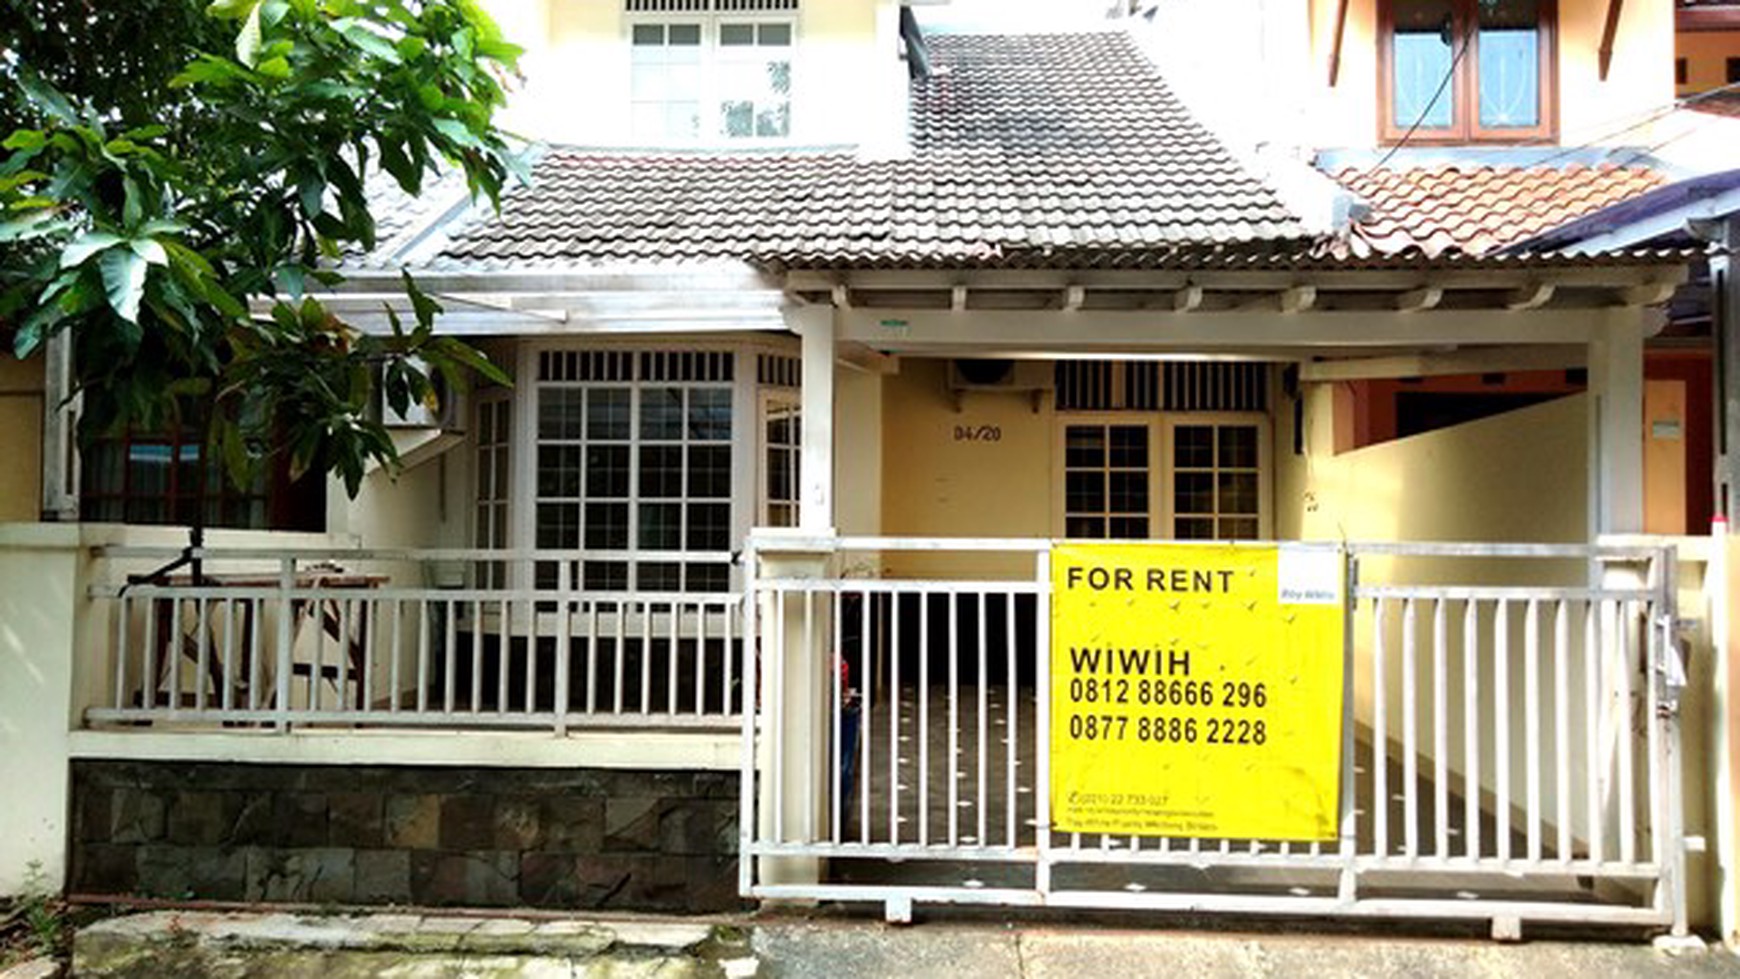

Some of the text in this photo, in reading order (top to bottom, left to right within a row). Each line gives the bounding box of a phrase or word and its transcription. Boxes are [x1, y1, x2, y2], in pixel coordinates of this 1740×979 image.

[1067, 567, 1234, 593] FOR RENT
[1069, 647, 1190, 676] WIWIH
[1070, 677, 1267, 708] 0812 88666 296
[1070, 714, 1266, 745] 0877 8886 2228
